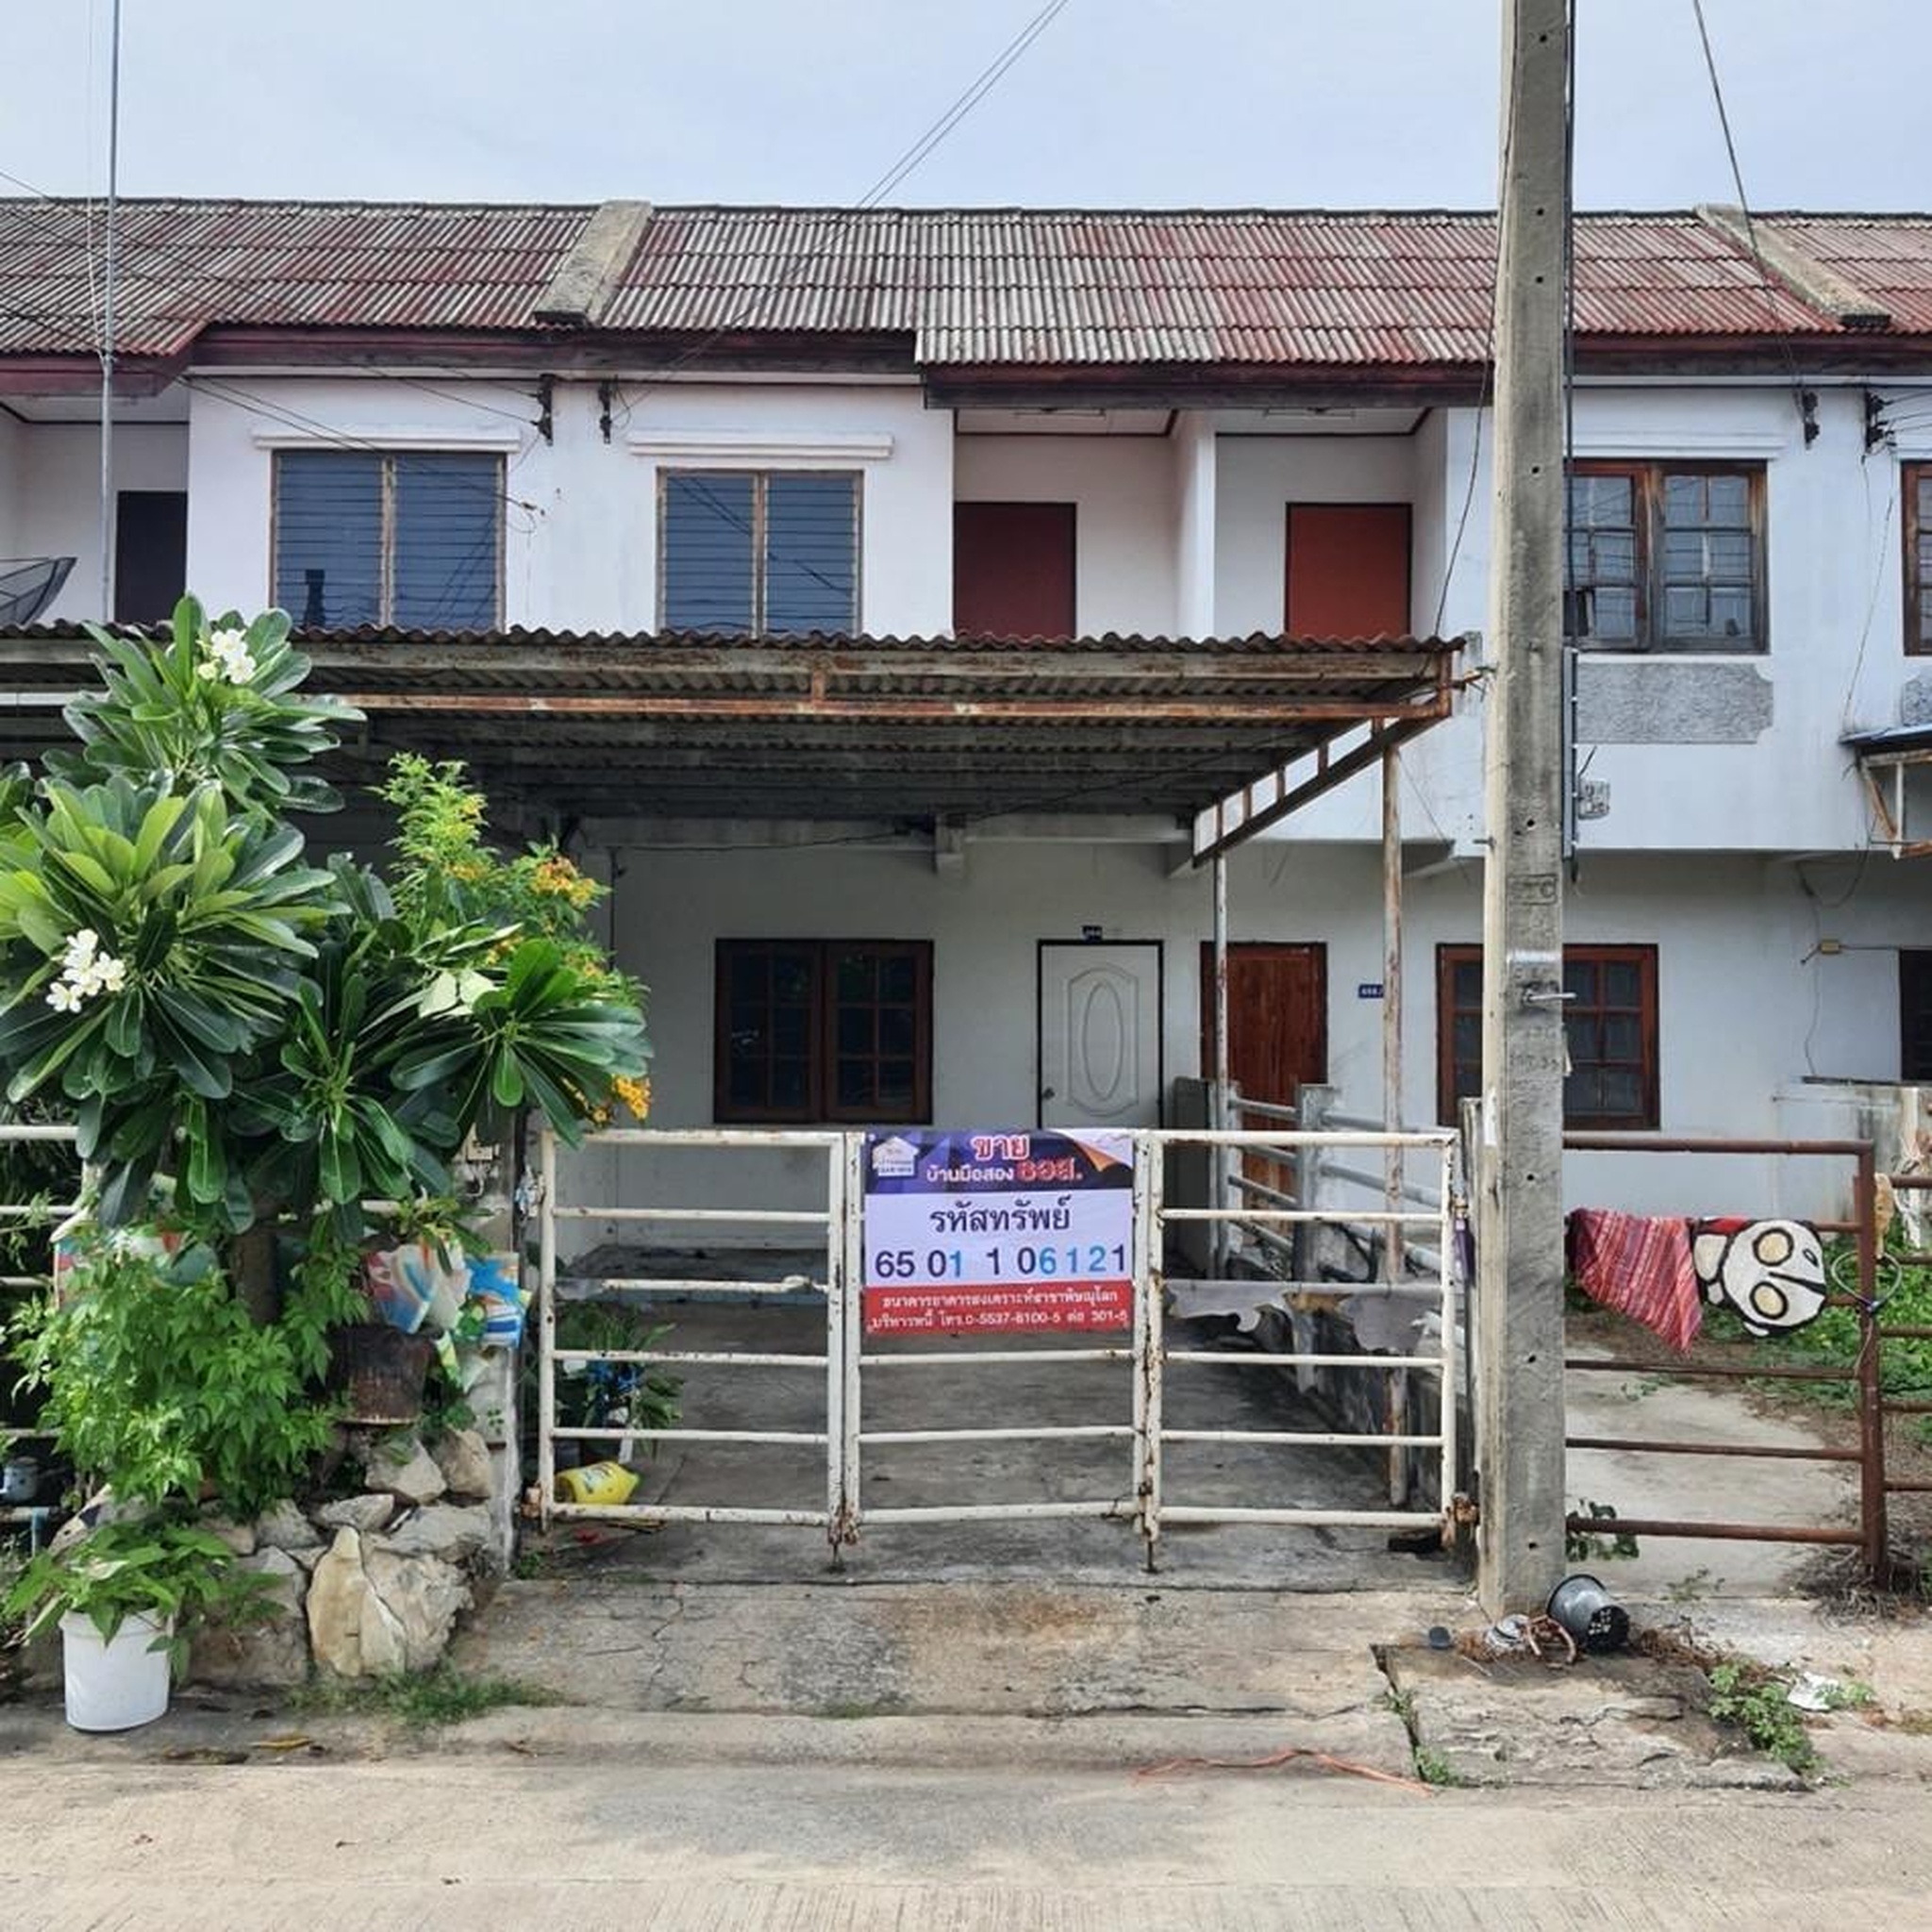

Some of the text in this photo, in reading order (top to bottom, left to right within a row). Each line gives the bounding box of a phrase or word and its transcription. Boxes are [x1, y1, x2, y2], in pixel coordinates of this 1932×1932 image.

[972, 1134, 1030, 1159] ขาย
[926, 1163, 1014, 1182] บ้านมือสอง
[929, 1195, 1072, 1233] รหัสทรัพย์
[874, 1250, 916, 1278] 65
[927, 1249, 962, 1277] 01
[986, 1247, 1000, 1275] 1
